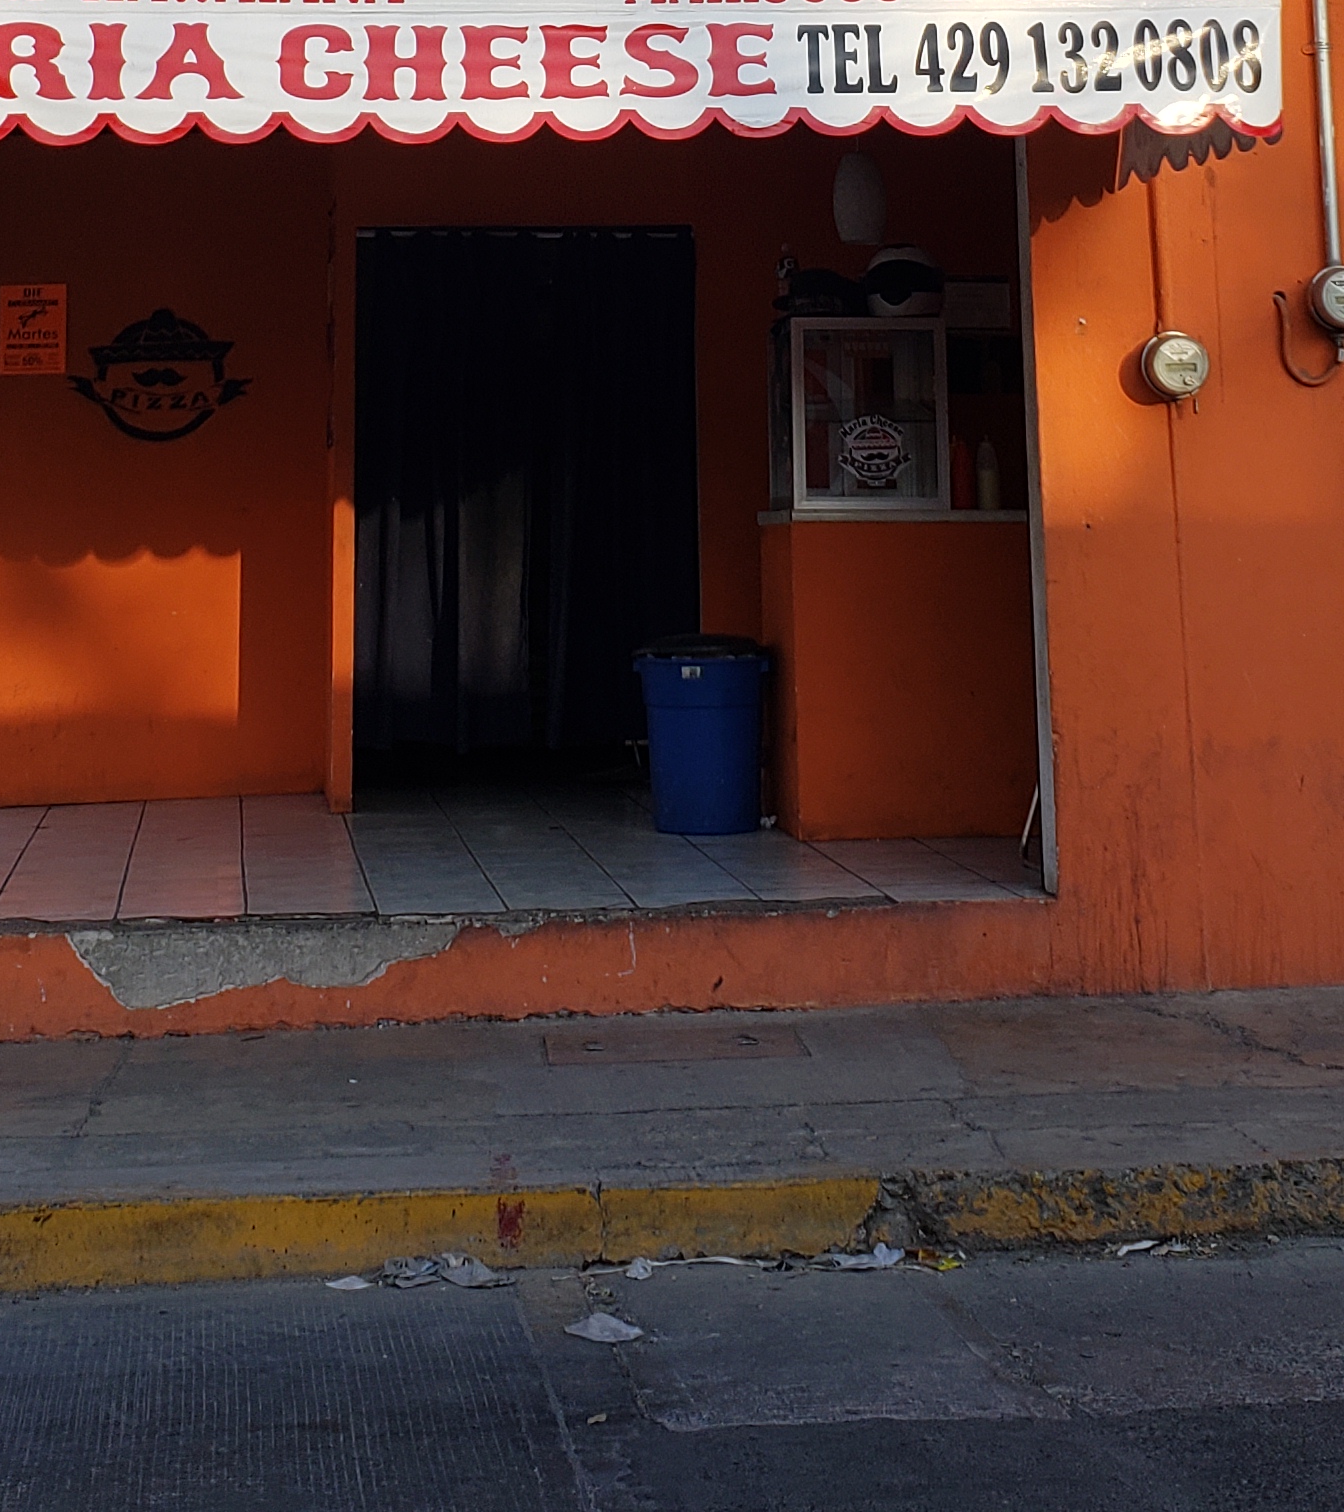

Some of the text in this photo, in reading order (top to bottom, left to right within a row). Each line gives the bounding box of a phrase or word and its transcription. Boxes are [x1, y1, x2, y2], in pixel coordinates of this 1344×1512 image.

[279, 23, 778, 101] CHEESE
[797, 24, 898, 94] TEL
[915, 20, 1010, 94] 429
[1026, 20, 1123, 94] 132
[1132, 18, 1263, 94] 0808
[8, 328, 58, 340] Martes
[109, 389, 211, 411] PIZZA
[840, 414, 904, 439] Maria Cheese
[853, 462, 897, 472] PIZZA
